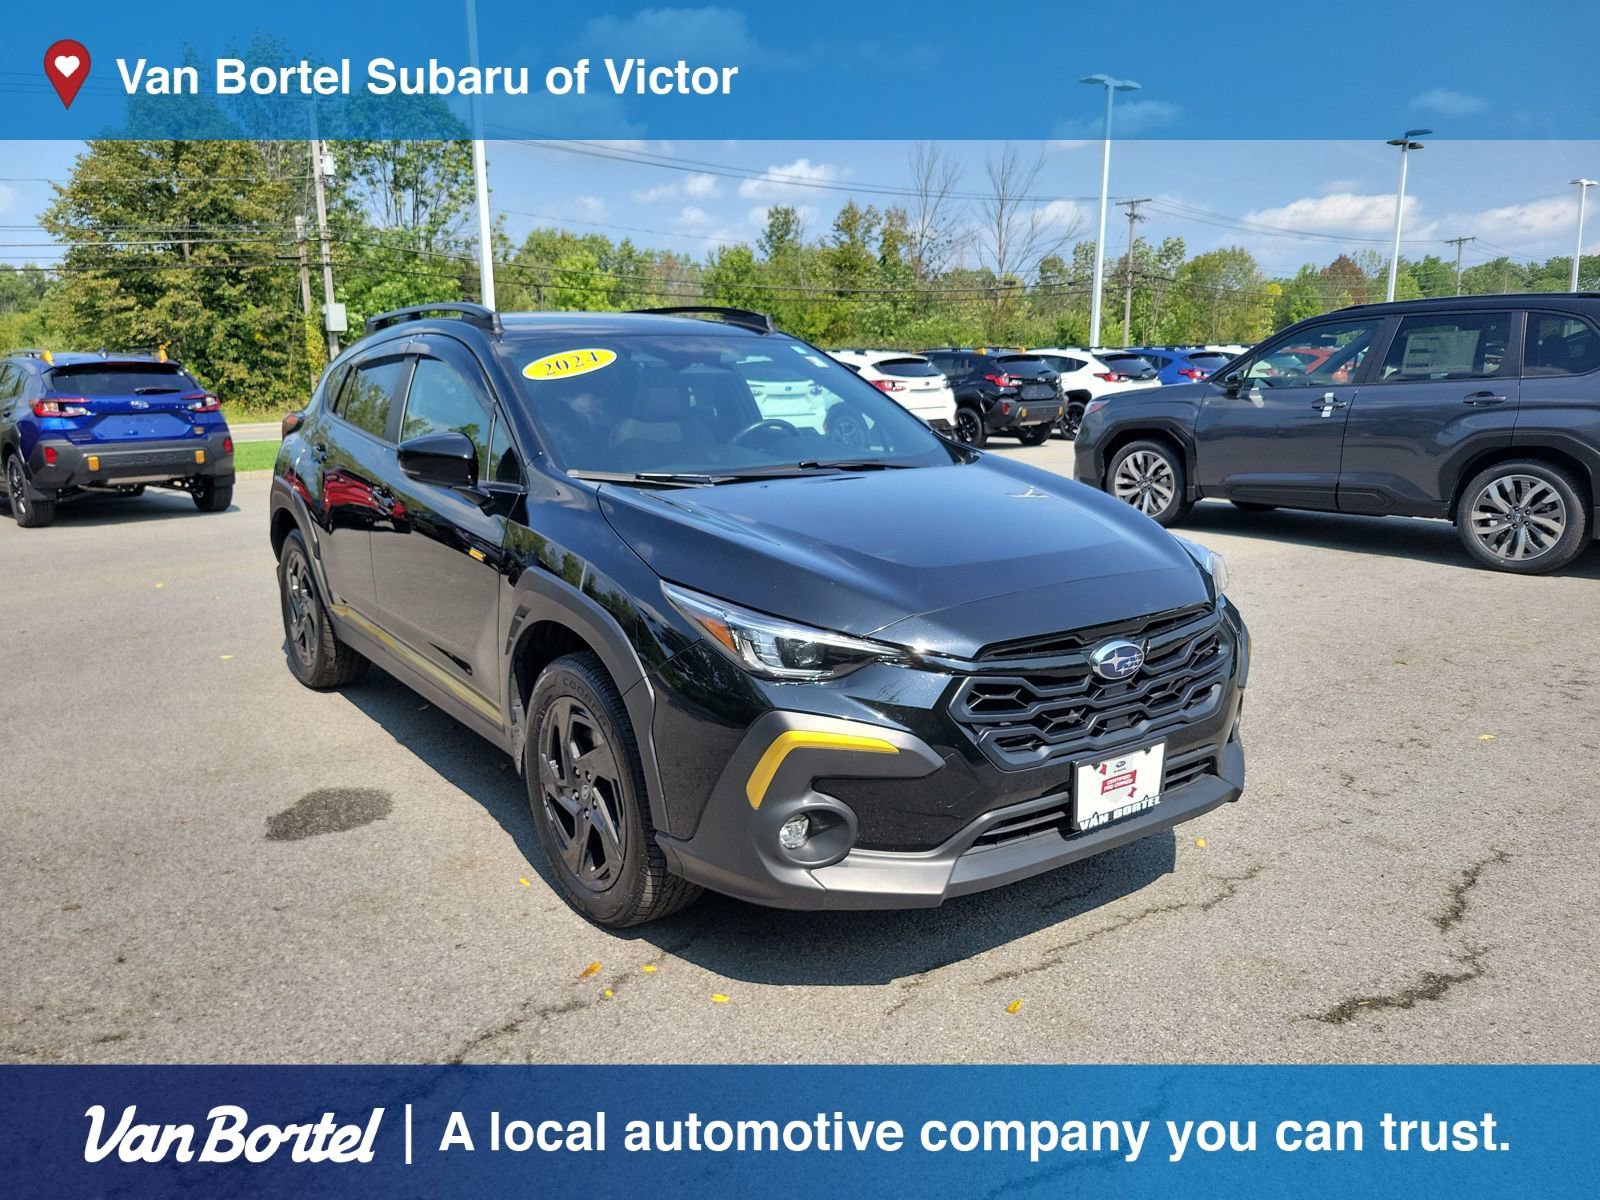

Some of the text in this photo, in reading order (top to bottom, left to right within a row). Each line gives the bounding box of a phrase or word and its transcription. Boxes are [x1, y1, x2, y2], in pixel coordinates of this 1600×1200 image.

[544, 351, 599, 376] 2024
[1080, 795, 1161, 831] VAN BORTEL
